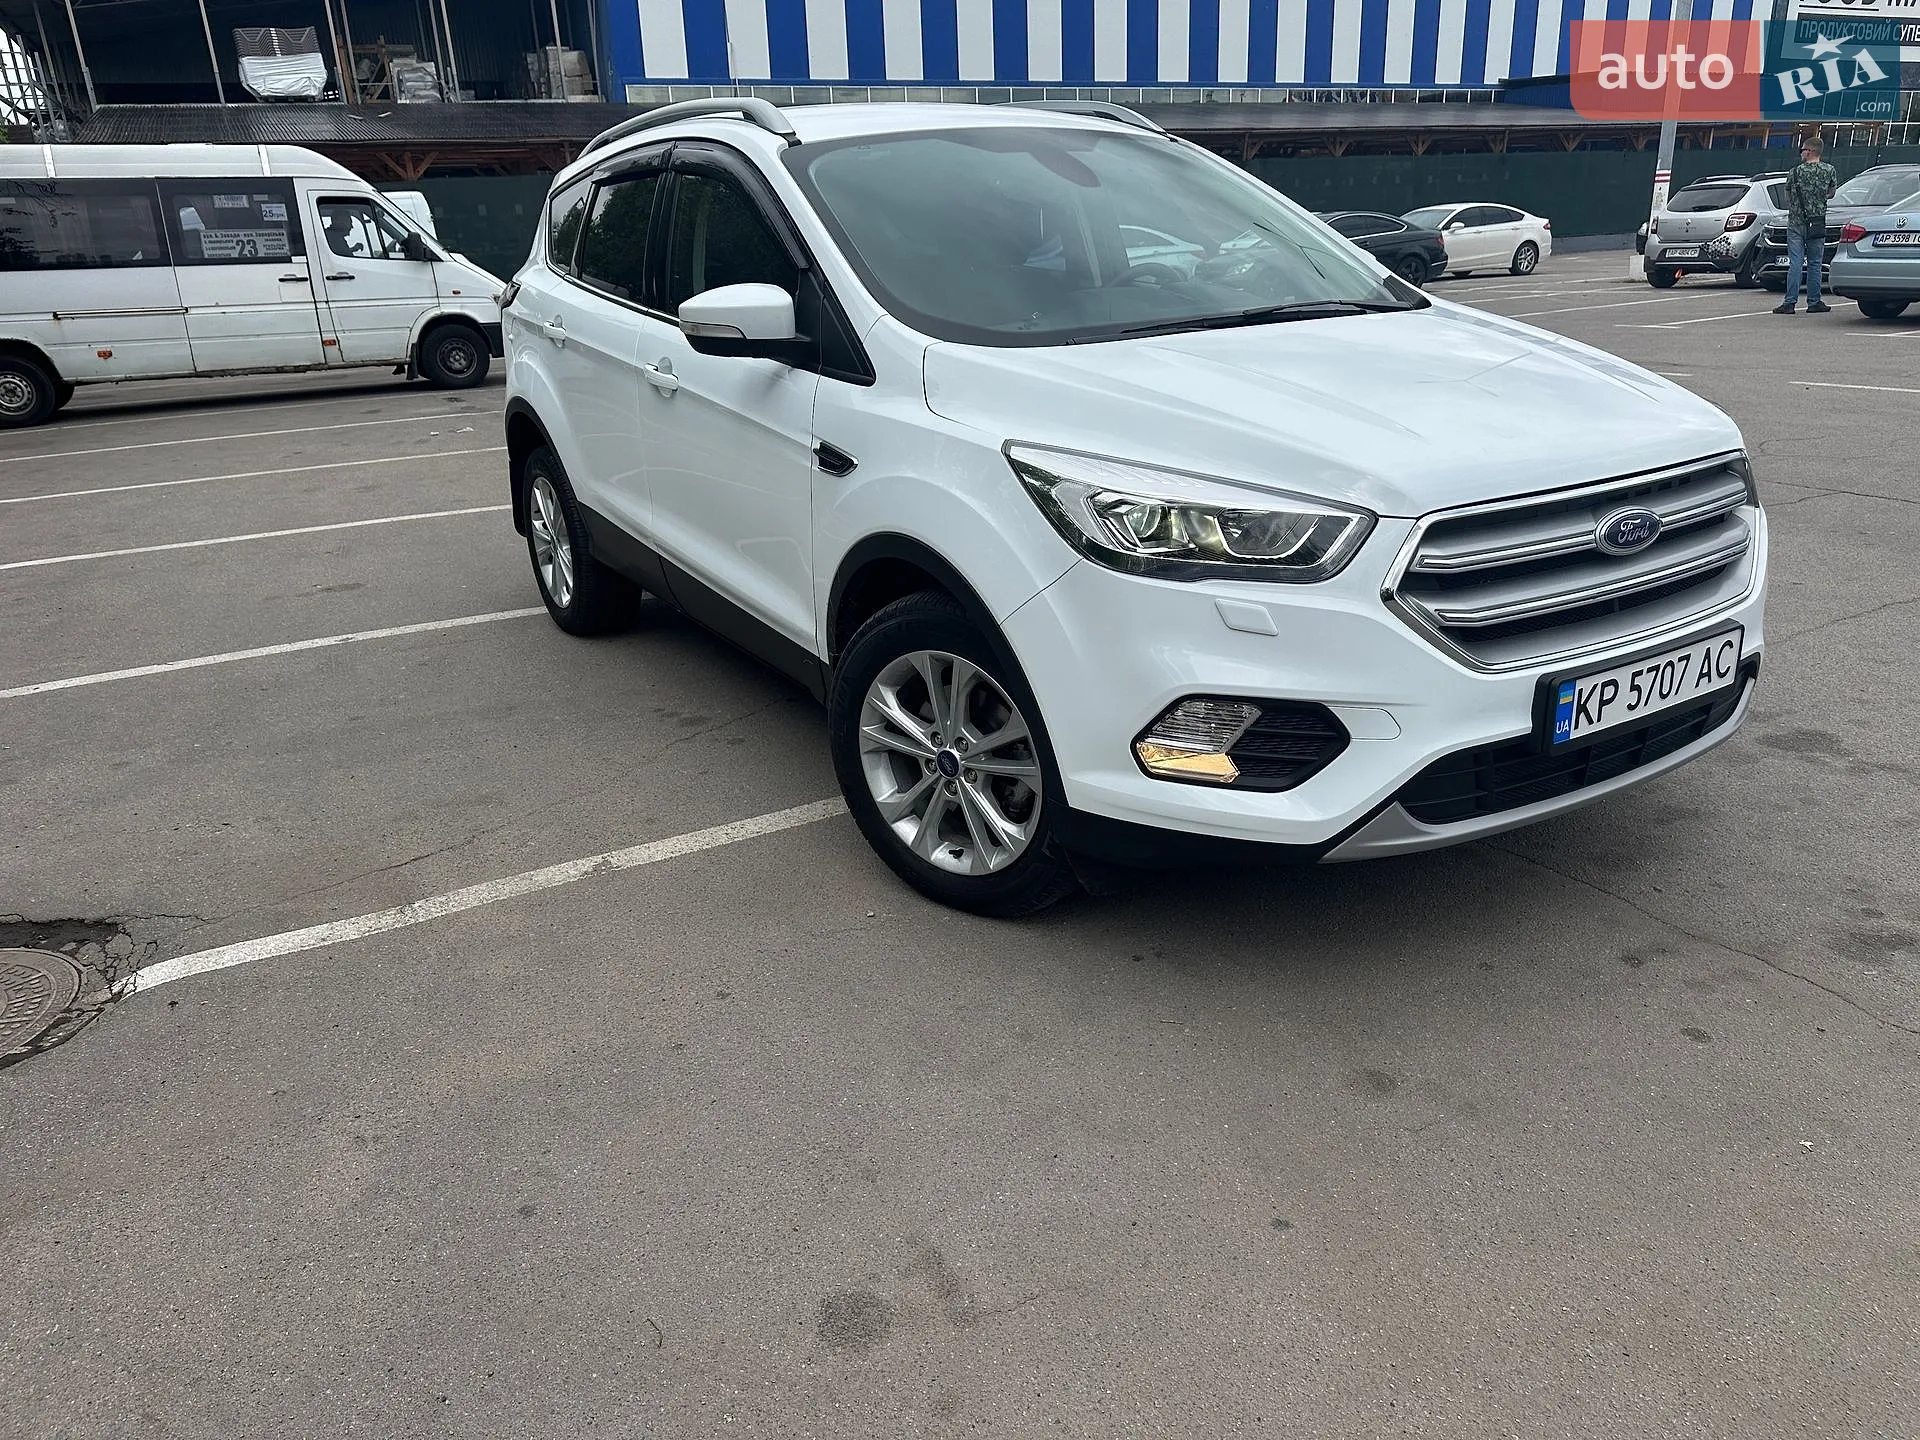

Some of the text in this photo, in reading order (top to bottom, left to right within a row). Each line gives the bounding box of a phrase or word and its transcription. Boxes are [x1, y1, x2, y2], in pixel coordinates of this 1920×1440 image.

[1800, 19, 1892, 41] ПРОДУКТОВИЙ
[235, 239, 259, 257] 23
[1879, 234, 1891, 243] AP
[1892, 234, 1911, 243] 3598
[1618, 518, 1650, 544] Ford
[1574, 639, 1734, 730] KP 5707 AC
[1556, 719, 1569, 734] UA
